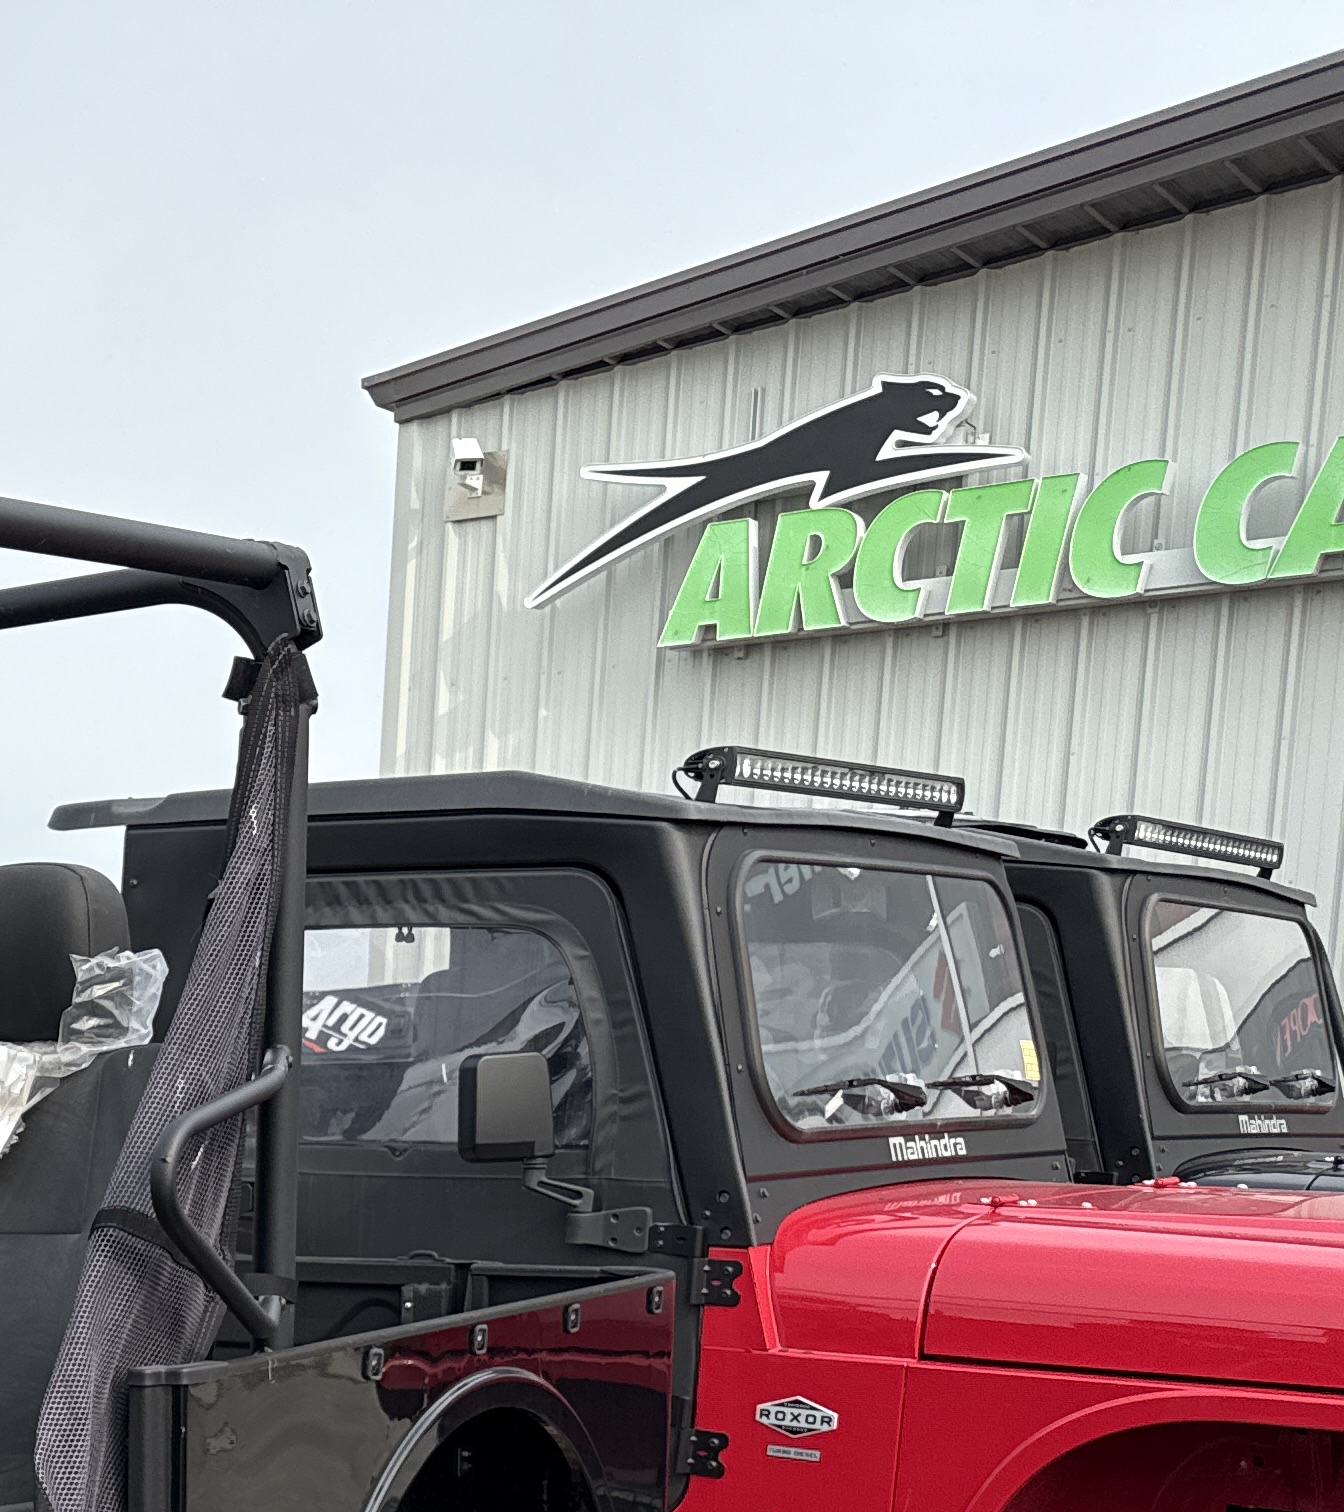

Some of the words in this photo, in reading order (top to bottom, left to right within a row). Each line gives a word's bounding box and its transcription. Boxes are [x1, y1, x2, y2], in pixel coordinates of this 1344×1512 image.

[657, 458, 1174, 649] ARCTIC
[1193, 435, 1344, 586] CA
[1238, 1114, 1289, 1134] Mahindra
[888, 1132, 967, 1162] Mahindra
[759, 1408, 833, 1427] ROXOR
